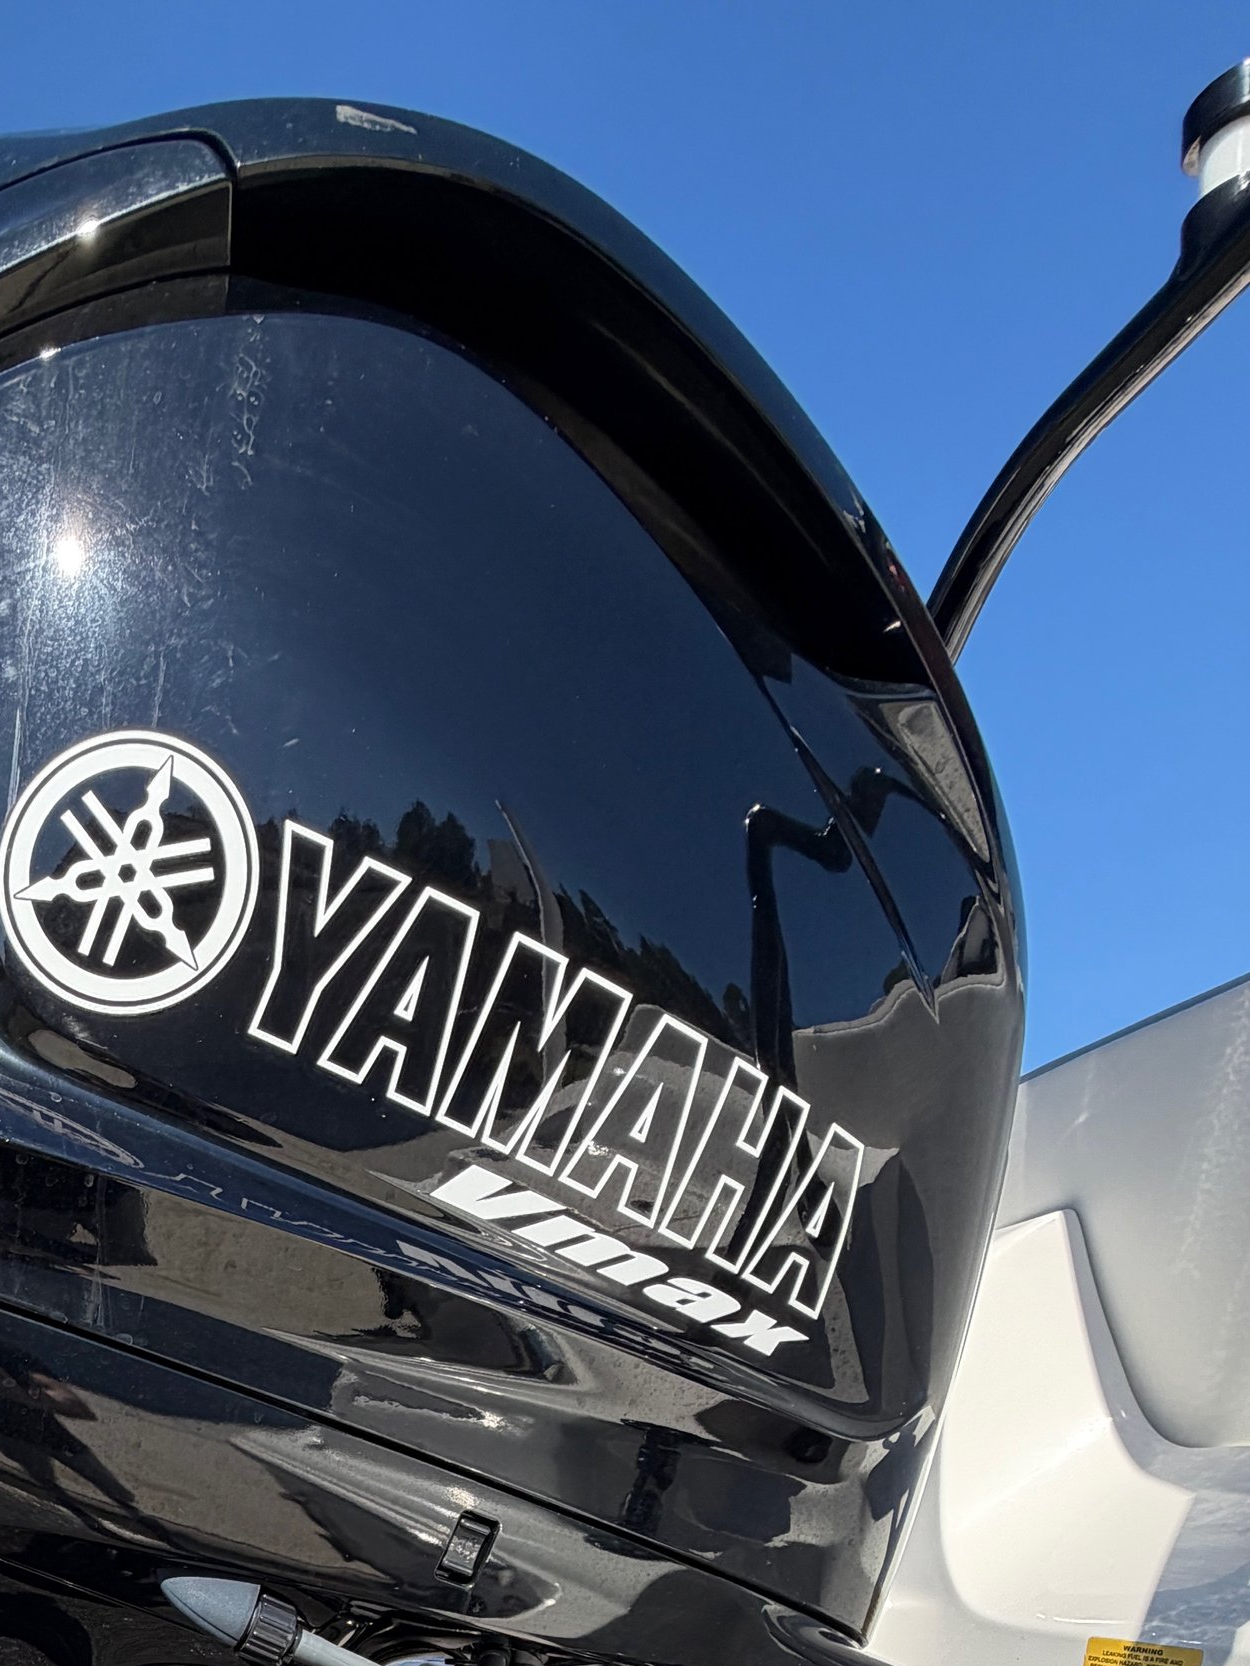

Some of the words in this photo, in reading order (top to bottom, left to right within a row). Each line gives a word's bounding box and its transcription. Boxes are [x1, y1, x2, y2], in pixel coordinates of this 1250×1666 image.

[248, 818, 865, 1320] YAMAHA
[1102, 1650, 1126, 1659] LEAKING
[1127, 1653, 1141, 1661] FUEL
[1123, 1645, 1163, 1656] WARNING
[1088, 1655, 1118, 1665] EXPLOSION
